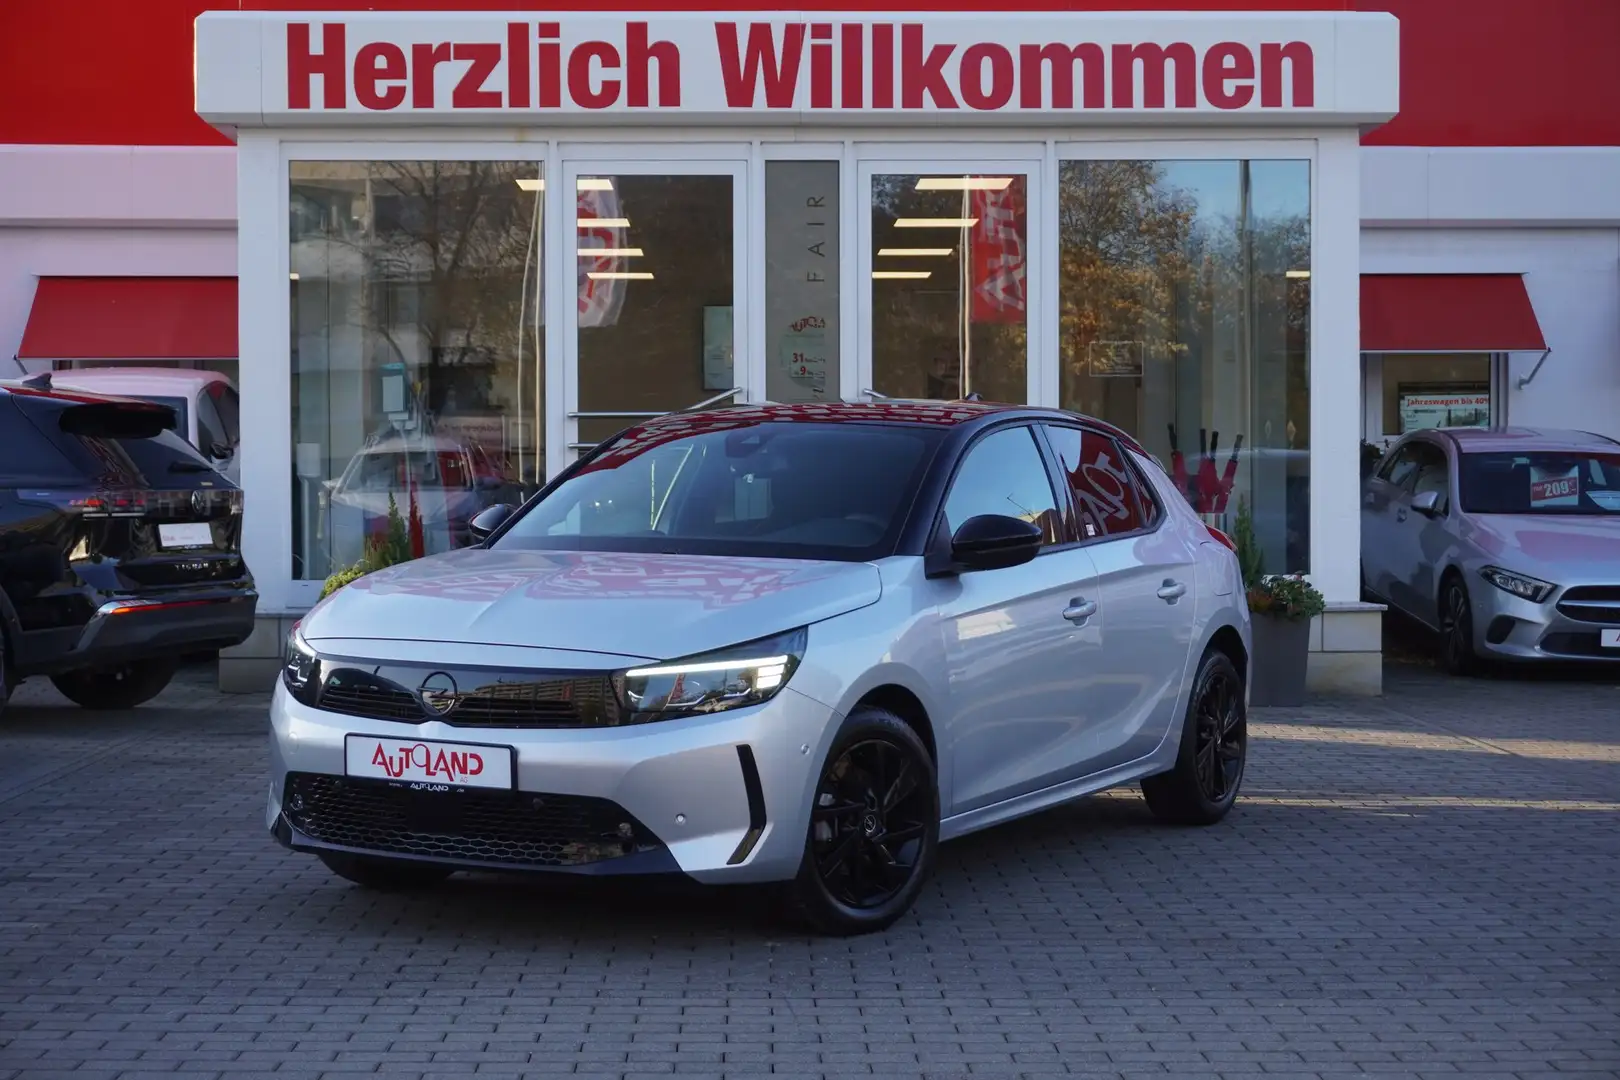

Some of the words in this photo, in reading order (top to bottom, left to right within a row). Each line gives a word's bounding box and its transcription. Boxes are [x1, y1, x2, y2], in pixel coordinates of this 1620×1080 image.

[286, 22, 681, 111] Herzlich
[715, 22, 1314, 111] Willkommen
[806, 196, 826, 282] FAIR
[1407, 398, 1459, 408] Jahreswagen
[1461, 397, 1472, 405] bis
[1543, 480, 1569, 497] 209
[372, 742, 484, 782] AUTOLAND
[410, 782, 449, 792] AUTOLAND
[459, 776, 469, 784] AG
